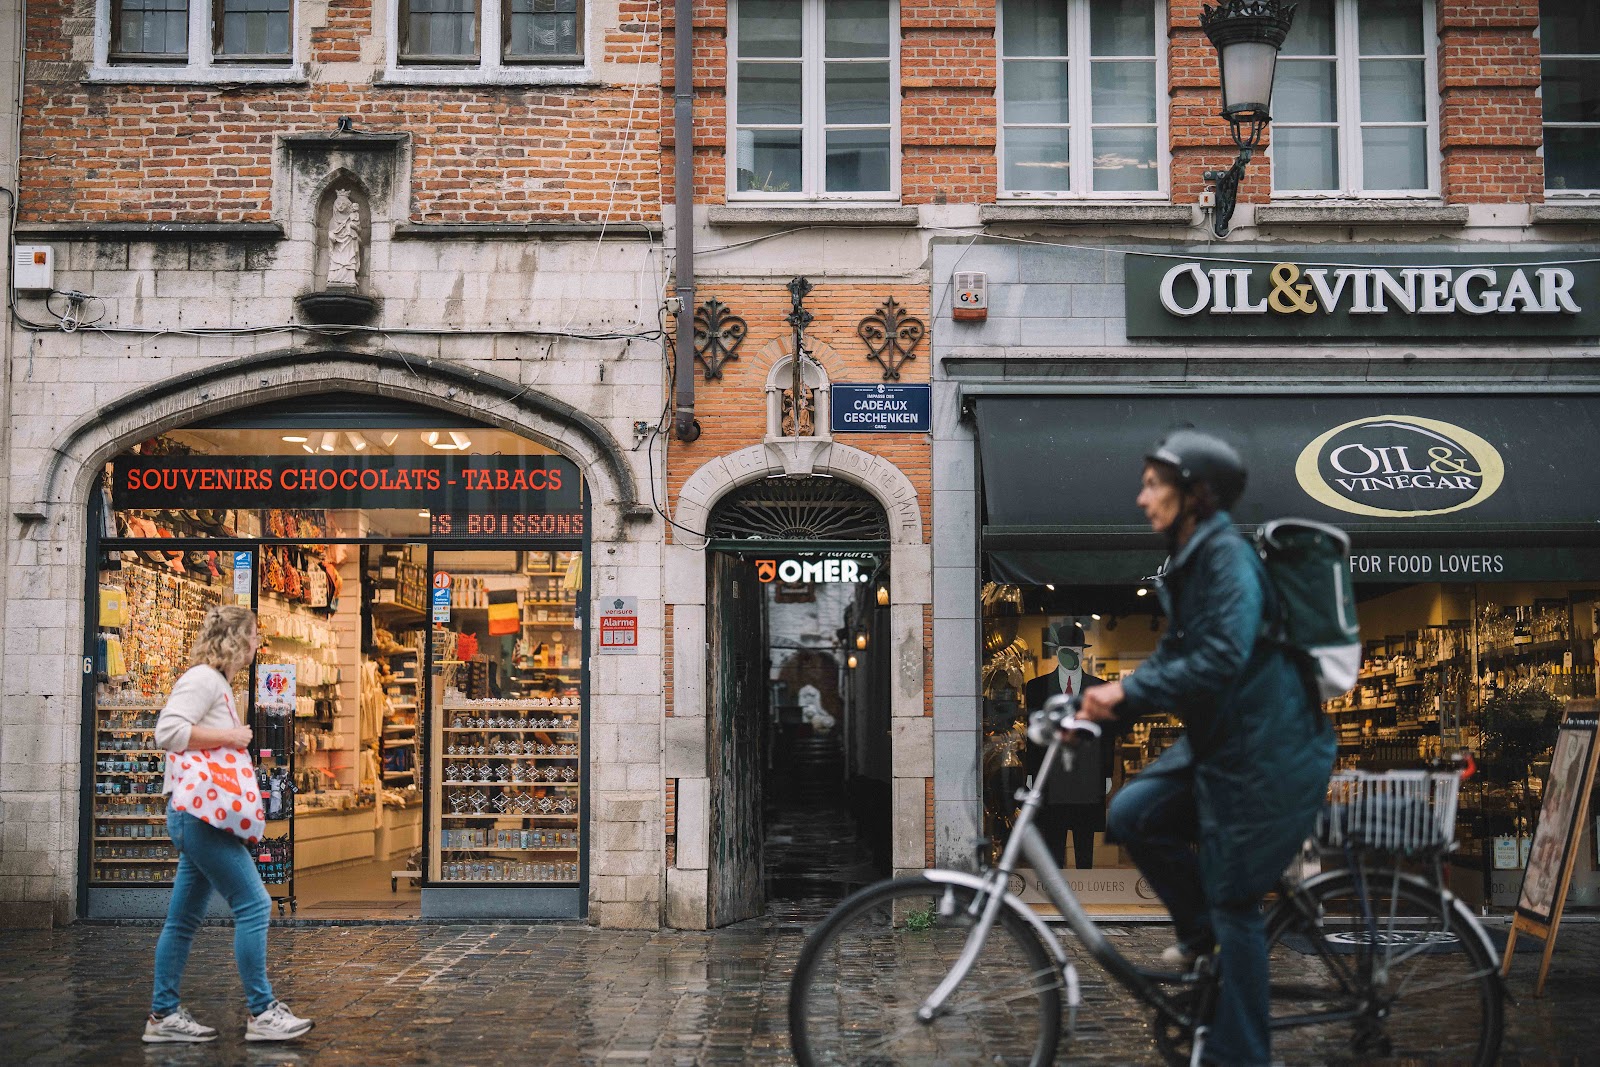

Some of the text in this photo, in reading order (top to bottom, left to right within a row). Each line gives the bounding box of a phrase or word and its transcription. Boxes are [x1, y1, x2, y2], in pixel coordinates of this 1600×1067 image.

[853, 400, 908, 411] CADEAUX
[843, 412, 919, 424] GESCHENKEN
[127, 468, 273, 490] SOUVENIRS
[279, 468, 441, 491] CHOCOLATS
[461, 469, 563, 491] TABACS
[1335, 474, 1478, 492] VINEGAR
[468, 514, 584, 534] BOISSONS
[778, 559, 869, 583] OMER.
[1350, 554, 1504, 573] FOR FOOD LOVERS
[603, 618, 635, 627] Alarme
[83, 657, 92, 674] 6
[1087, 881, 1125, 892] LOVERS
